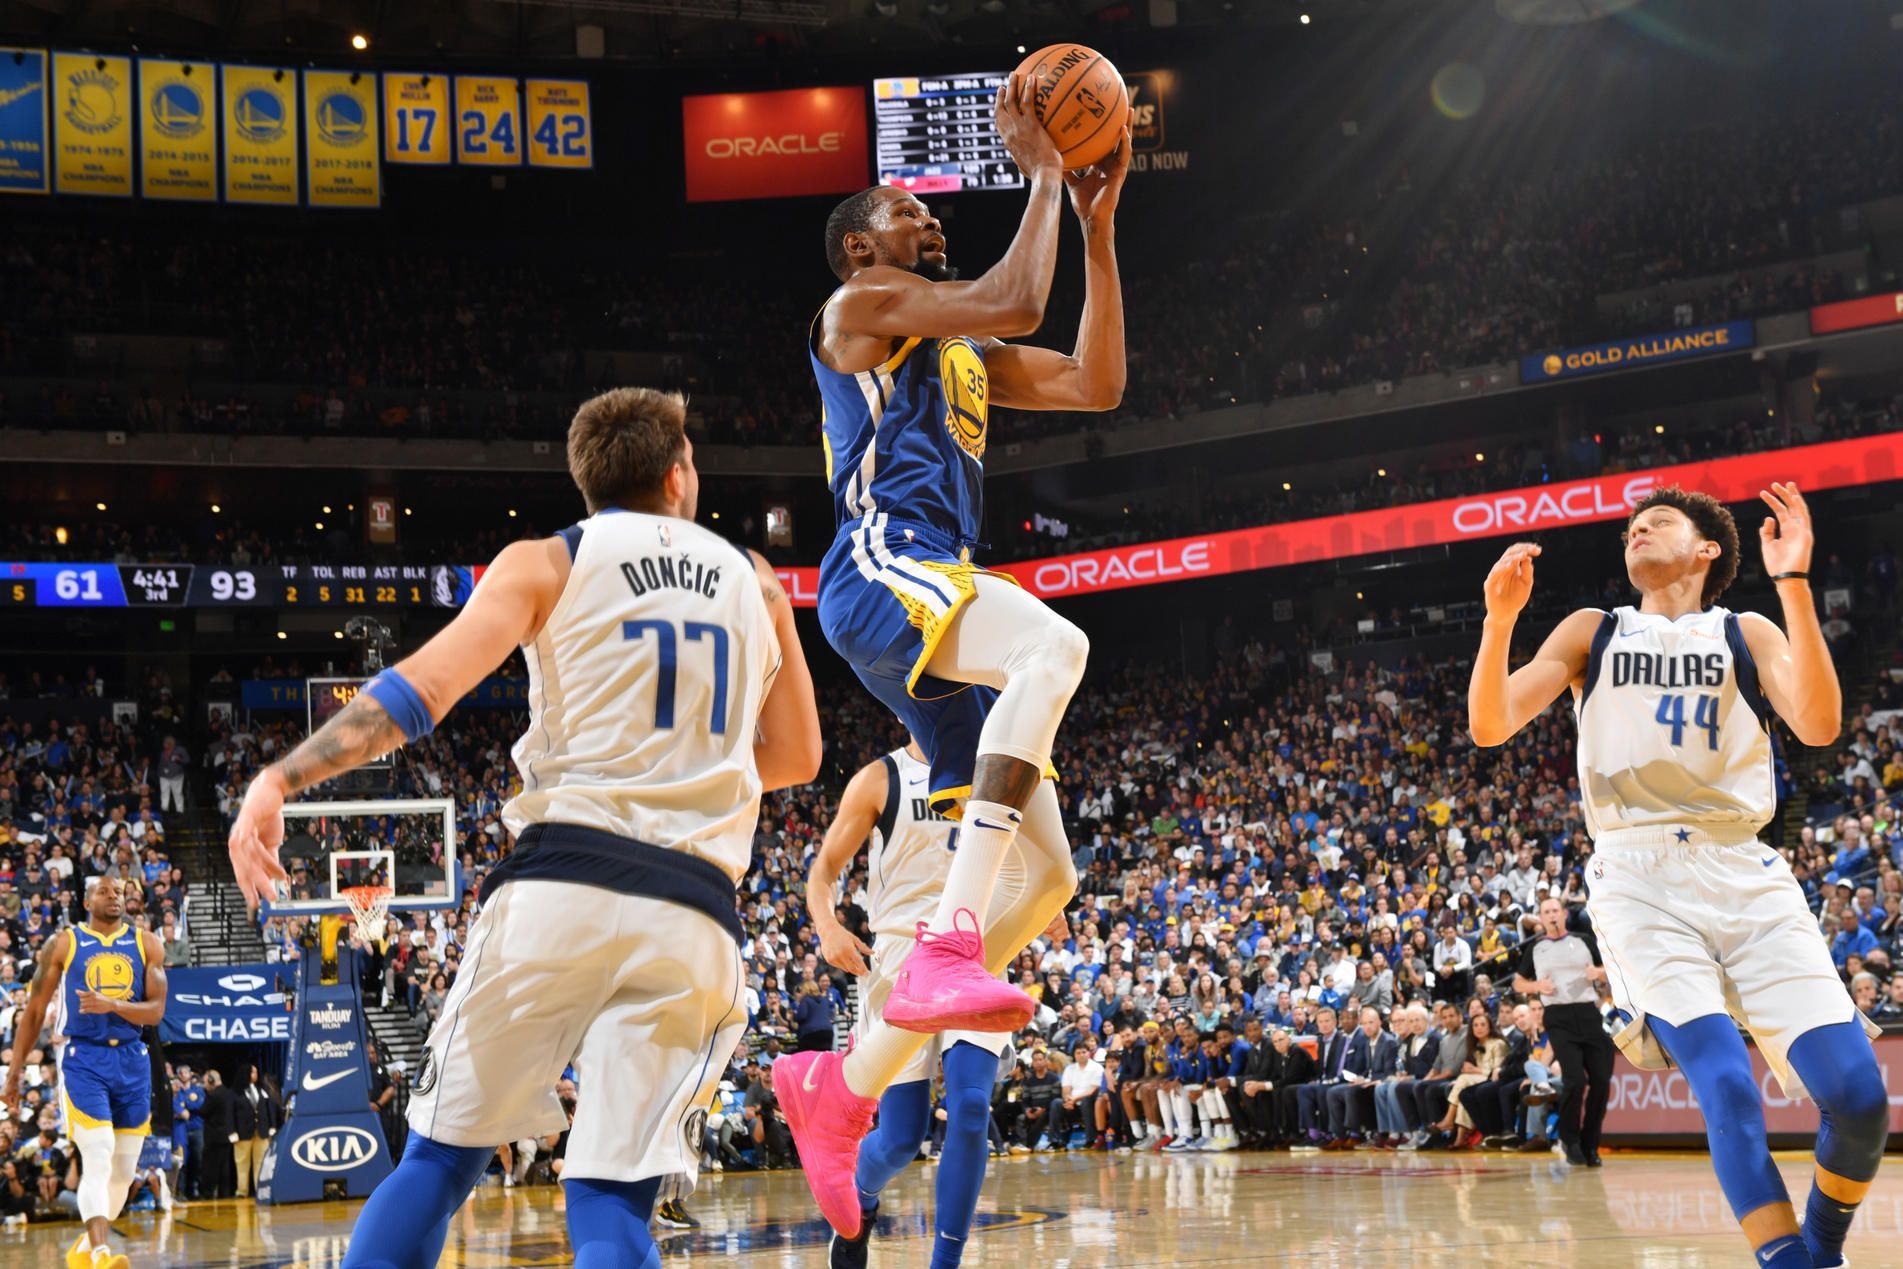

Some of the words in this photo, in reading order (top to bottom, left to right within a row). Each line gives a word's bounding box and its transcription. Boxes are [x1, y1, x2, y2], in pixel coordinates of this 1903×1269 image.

[397, 107, 437, 152] 17
[462, 110, 515, 154] 24
[534, 113, 587, 156] 42
[706, 132, 841, 158] ORACLE
[1152, 152, 1189, 171] NOW
[1566, 347, 1623, 370] GOLD
[1626, 328, 1729, 360] ALLIANCE
[967, 368, 985, 401] 35
[1452, 476, 1656, 534] ORACLE
[132, 569, 179, 588] 4:41
[281, 566, 297, 579] TF
[312, 566, 335, 579] TOL
[342, 566, 366, 579] REB
[374, 566, 397, 579] AST
[403, 566, 426, 579] BLK
[620, 553, 722, 600] DONČIĆ
[1034, 542, 1211, 592] ORACLE
[13, 585, 25, 601] 5
[55, 569, 103, 600] 61
[210, 570, 256, 600] 93
[286, 586, 297, 602] 2
[319, 586, 330, 602] 5
[346, 587, 365, 602] 31
[376, 587, 396, 602] 22
[410, 587, 421, 602] 1
[622, 619, 729, 735] 77
[1612, 652, 1724, 688] DALLAS
[1655, 694, 1720, 752] 44
[113, 964, 122, 975] 9
[175, 992, 287, 1007] CHAS
[185, 1016, 290, 1040] CHASE
[1606, 1071, 1700, 1111] ORACL
[306, 1135, 365, 1163] KIA
